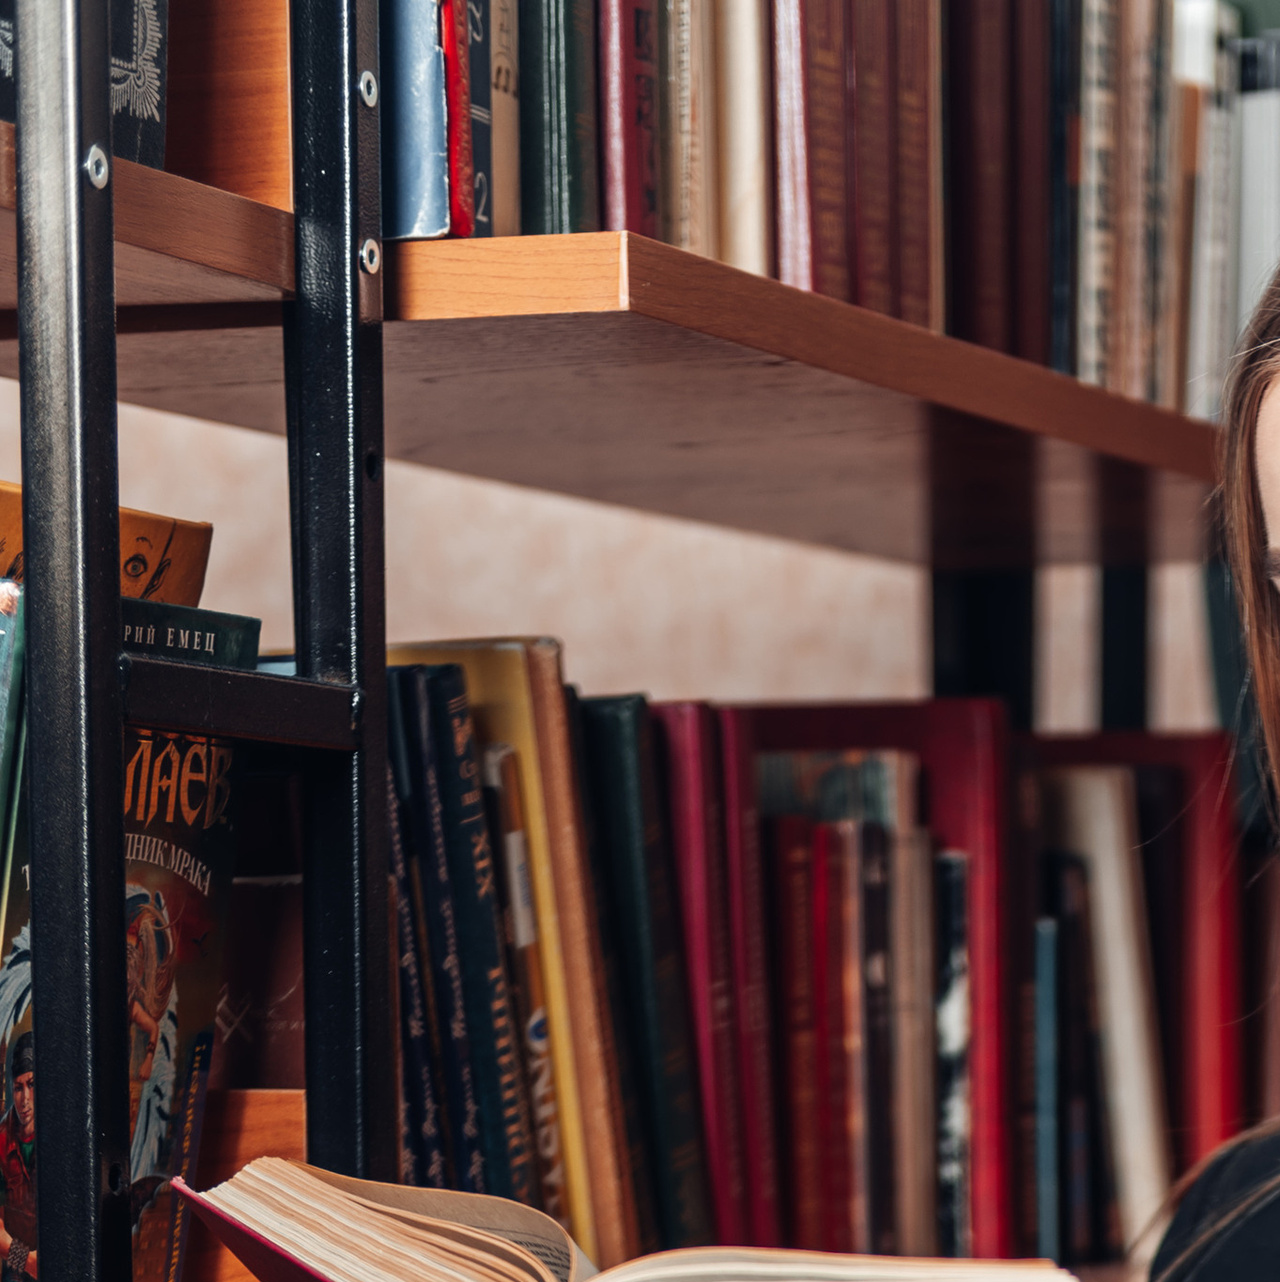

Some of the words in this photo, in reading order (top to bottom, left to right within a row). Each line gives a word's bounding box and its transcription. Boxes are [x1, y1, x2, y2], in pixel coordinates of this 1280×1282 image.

[165, 627, 216, 656] ЕМЕЦ
[123, 738, 233, 831] ЛАЕВ
[124, 832, 169, 867] ДНИК
[166, 843, 212, 898] МРАКА
